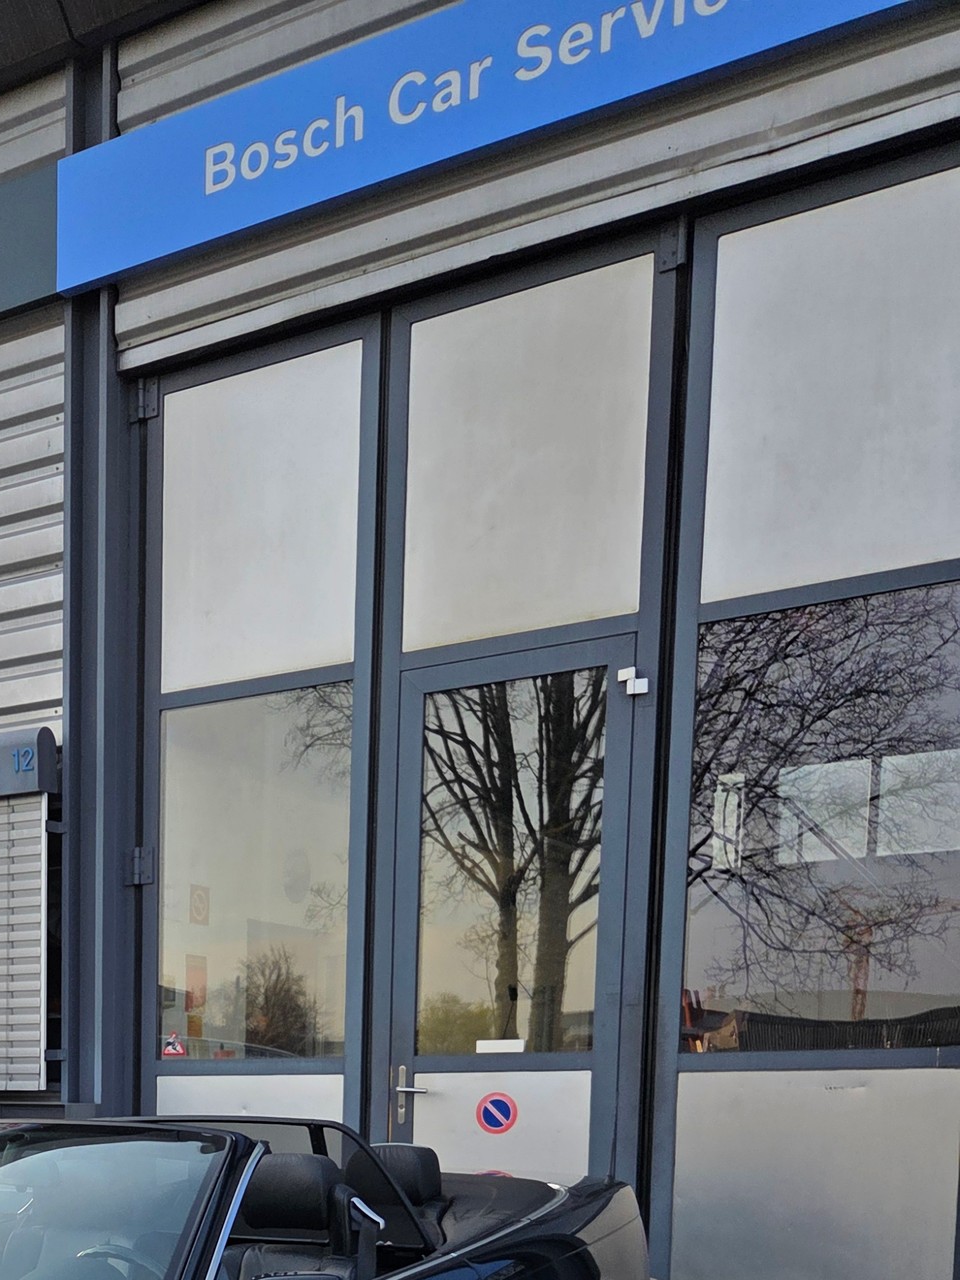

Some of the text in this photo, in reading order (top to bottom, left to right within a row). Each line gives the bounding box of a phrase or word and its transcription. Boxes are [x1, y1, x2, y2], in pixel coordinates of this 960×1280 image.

[204, 96, 364, 195] Bosch
[388, 56, 493, 125] Car
[11, 747, 34, 773] 12
